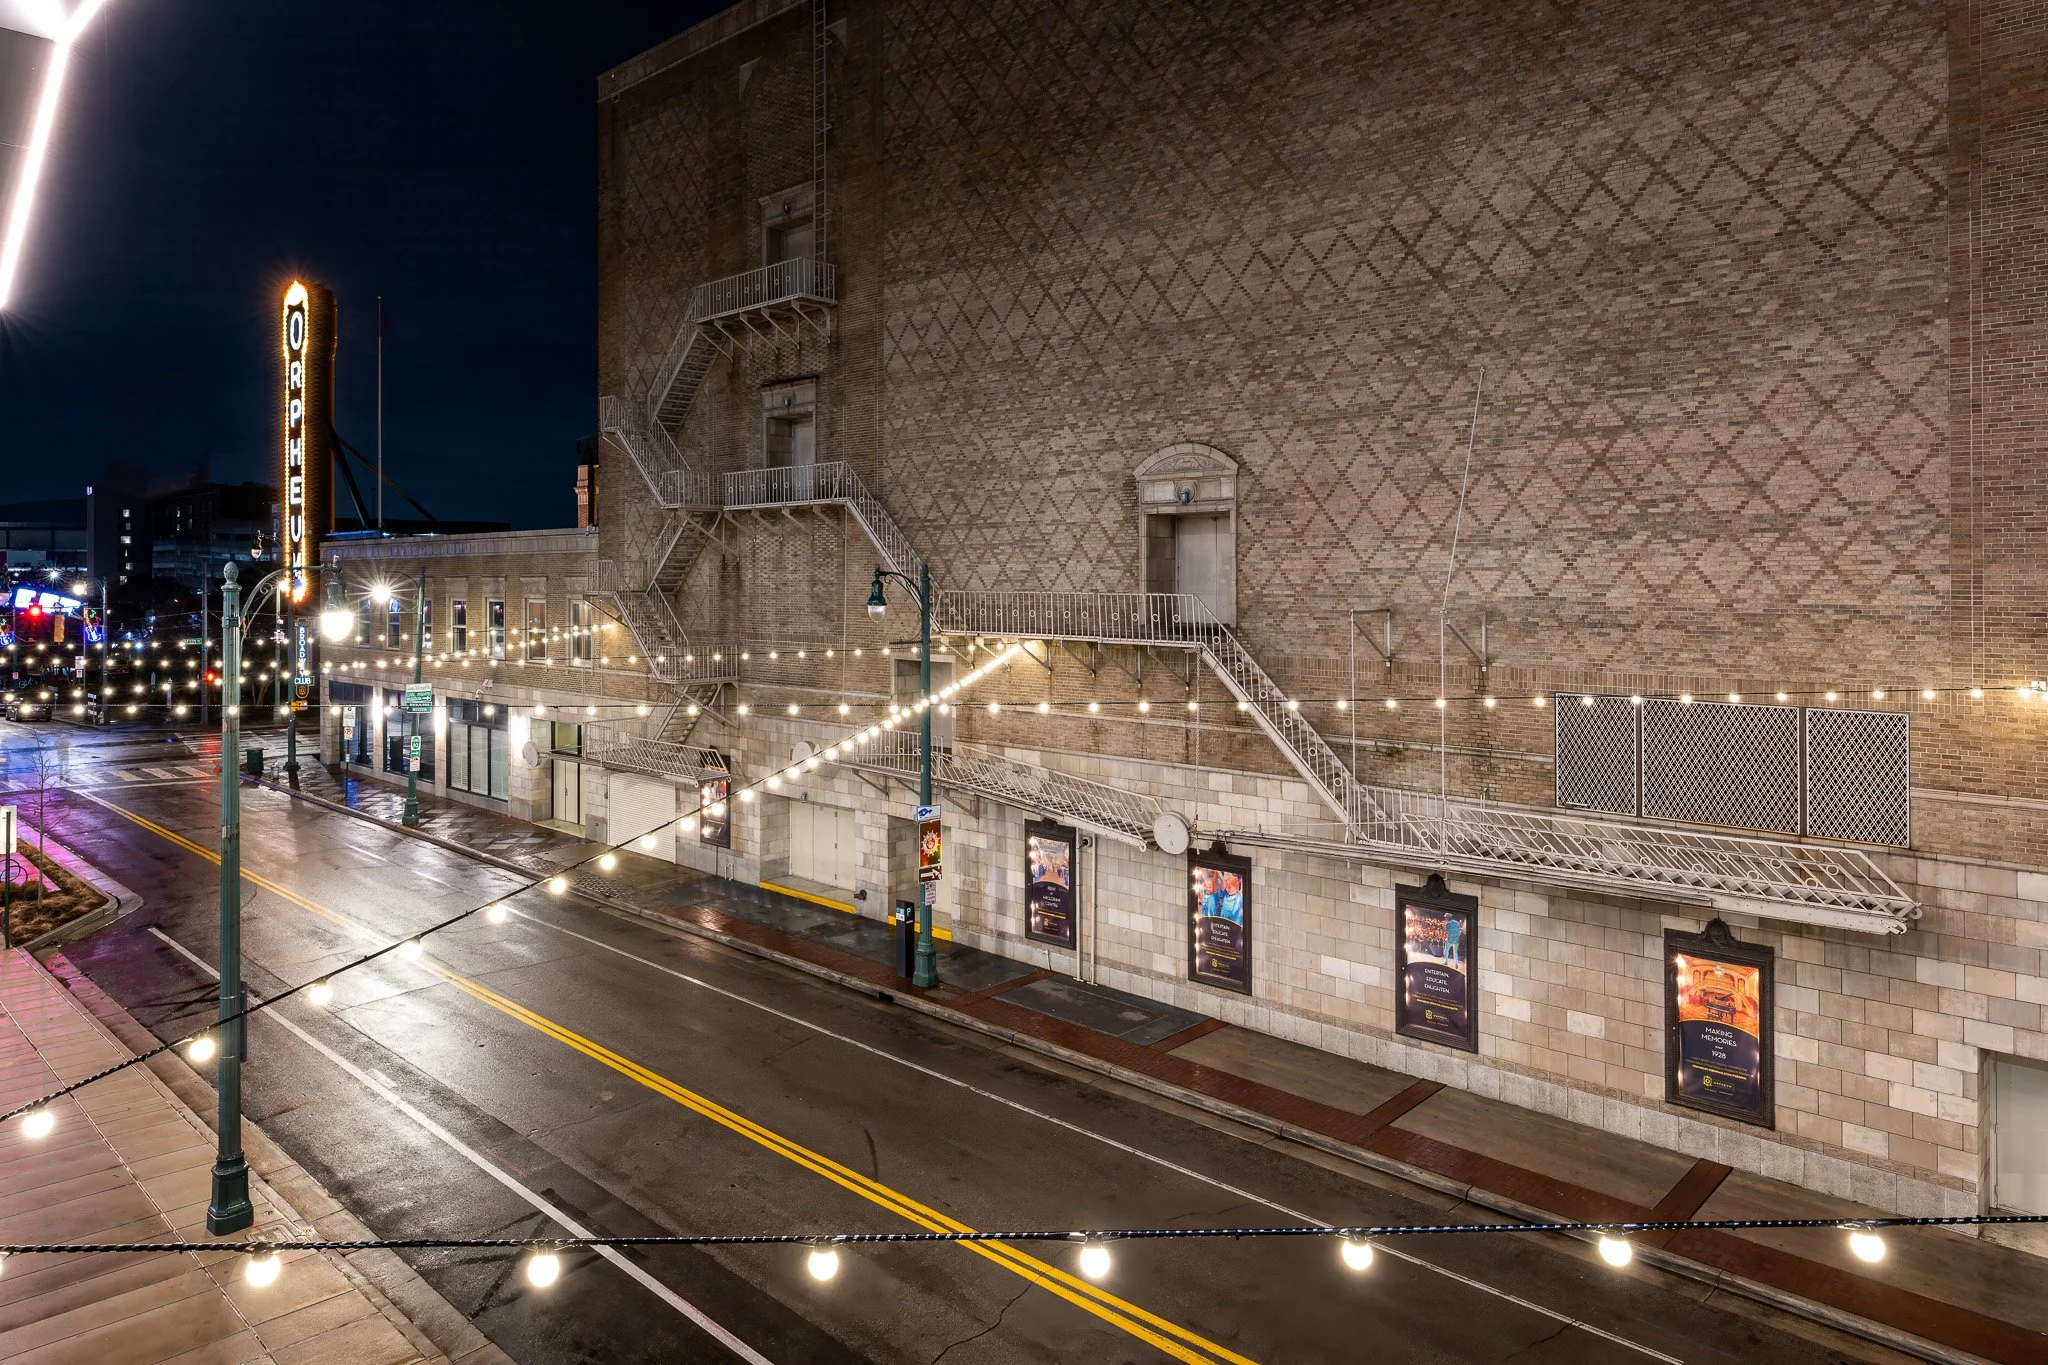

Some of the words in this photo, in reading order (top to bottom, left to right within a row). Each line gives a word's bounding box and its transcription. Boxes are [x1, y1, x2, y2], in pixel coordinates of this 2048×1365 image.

[294, 677, 311, 685] CLUB
[1705, 1027, 1733, 1038] MAKING
[1701, 1033, 1737, 1047] MEMORIES
[1711, 1050, 1727, 1059] 1928
